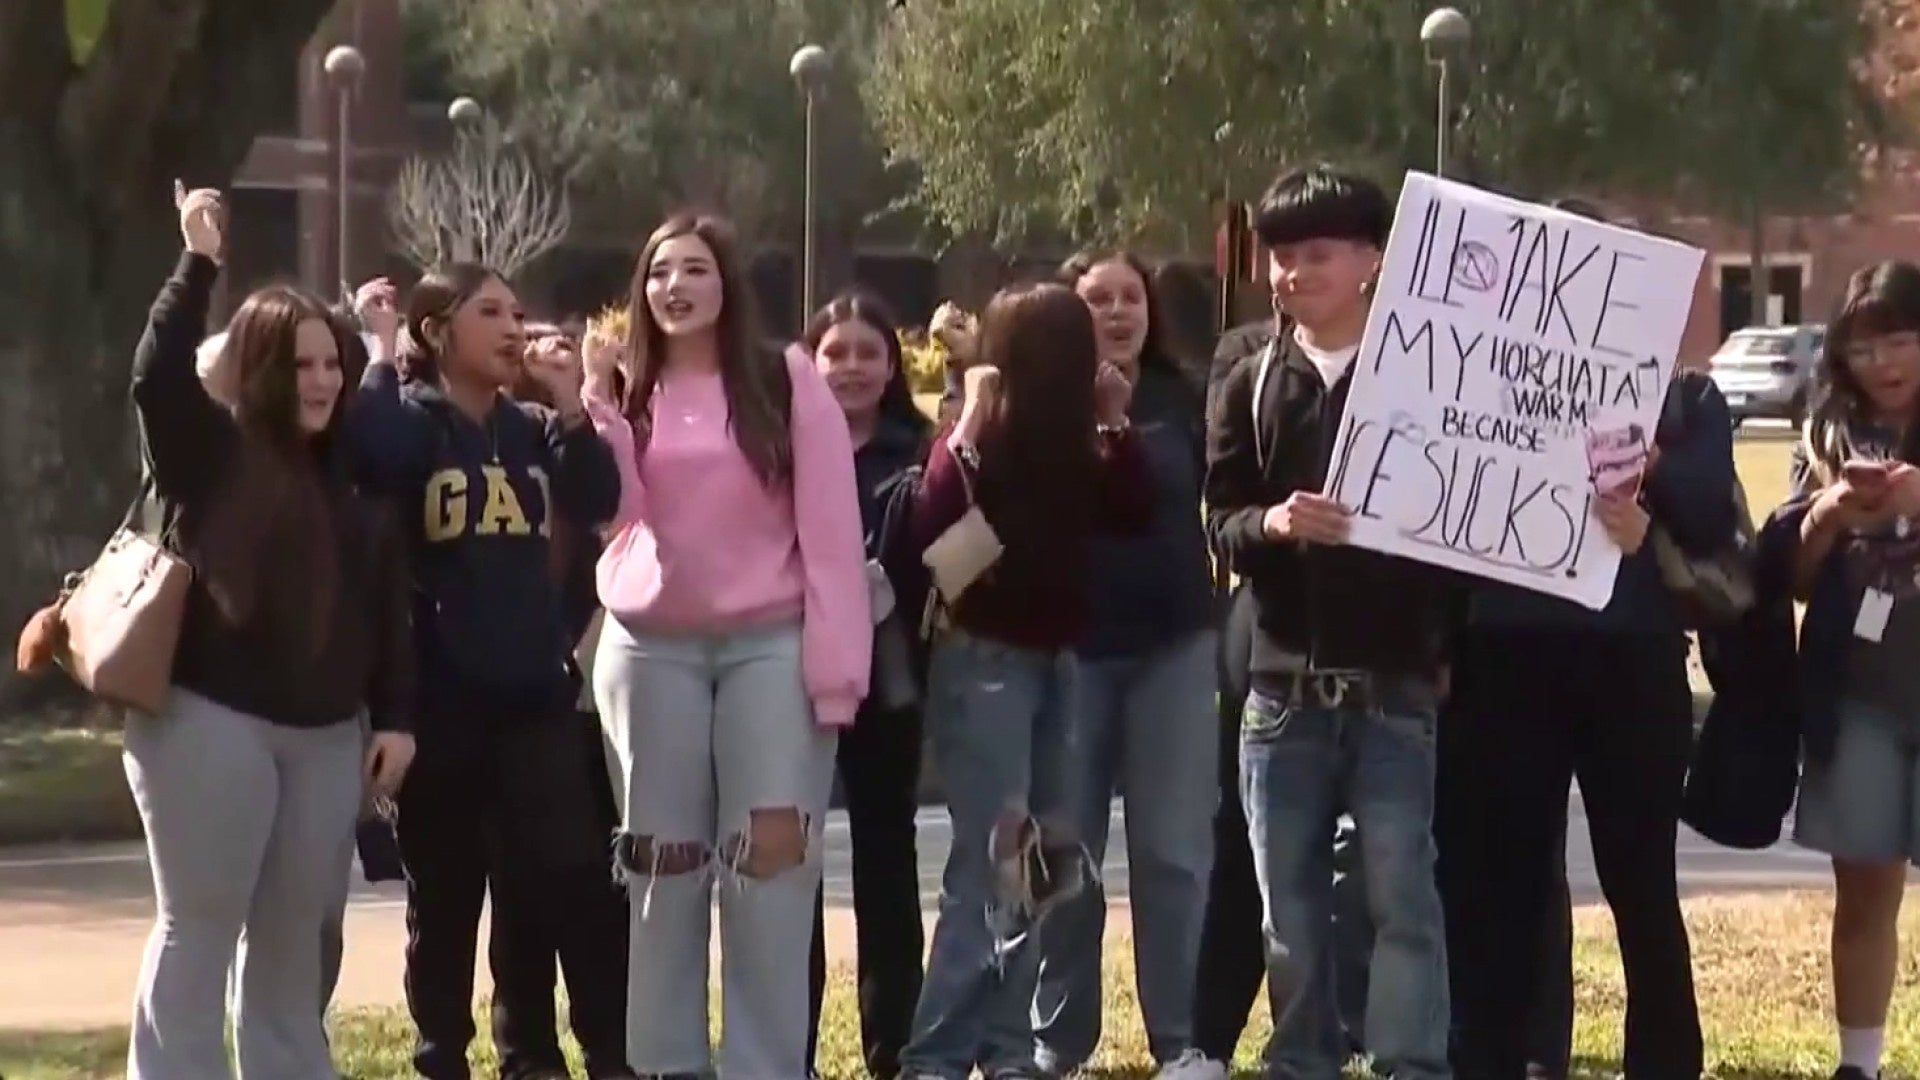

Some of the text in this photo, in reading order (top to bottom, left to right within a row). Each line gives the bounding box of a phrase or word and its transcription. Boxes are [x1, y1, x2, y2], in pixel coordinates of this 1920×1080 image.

[1498, 214, 1647, 358] TAKE
[1374, 310, 1639, 410] MY HORCHATA
[1512, 386, 1588, 428] WARM
[1442, 405, 1547, 453] BECAUSE
[1329, 414, 1592, 579] ICE SUCKS!
